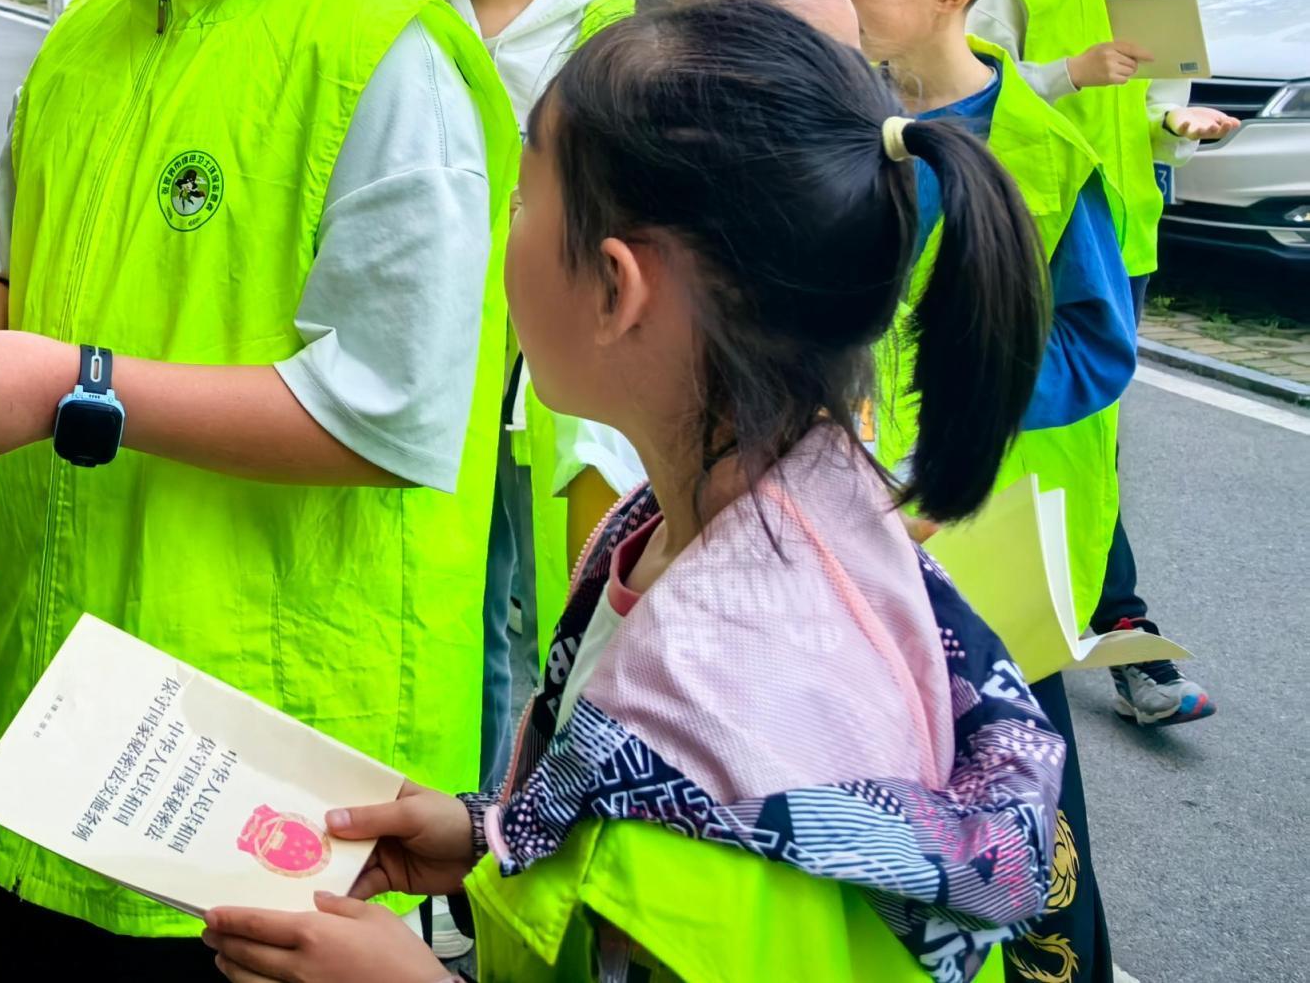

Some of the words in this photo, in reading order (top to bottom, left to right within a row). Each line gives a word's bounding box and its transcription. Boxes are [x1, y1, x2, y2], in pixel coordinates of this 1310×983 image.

[33, 694, 64, 738] 法律出版社
[71, 676, 182, 842] 保守国家秘密法实施条例
[112, 721, 185, 827] 中华人民共和国
[144, 735, 217, 841] 保守国家秘密法
[167, 749, 238, 854] 中华人民共和国
